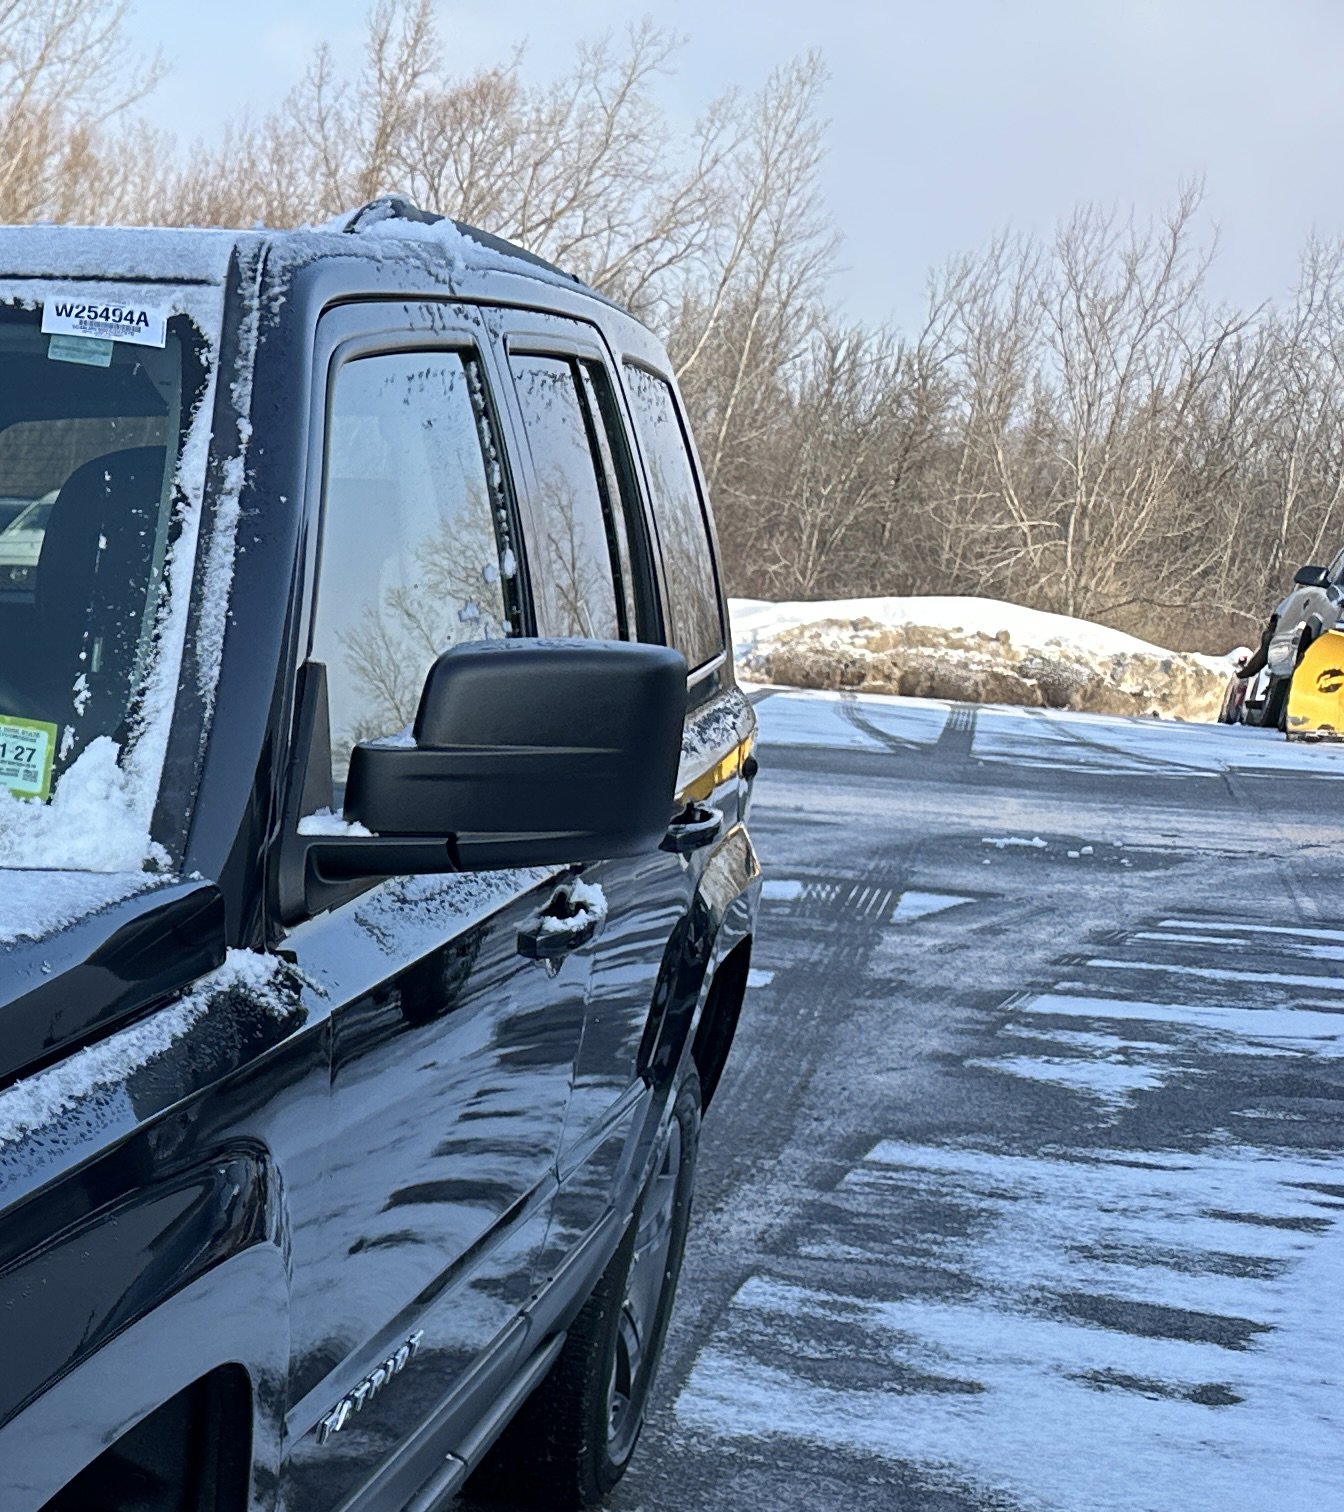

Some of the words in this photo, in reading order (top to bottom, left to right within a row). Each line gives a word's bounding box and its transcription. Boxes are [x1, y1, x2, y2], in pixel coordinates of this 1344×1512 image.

[55, 302, 149, 328] W25494A
[14, 745, 36, 762] 27
[316, 1329, 424, 1445] Patriot
